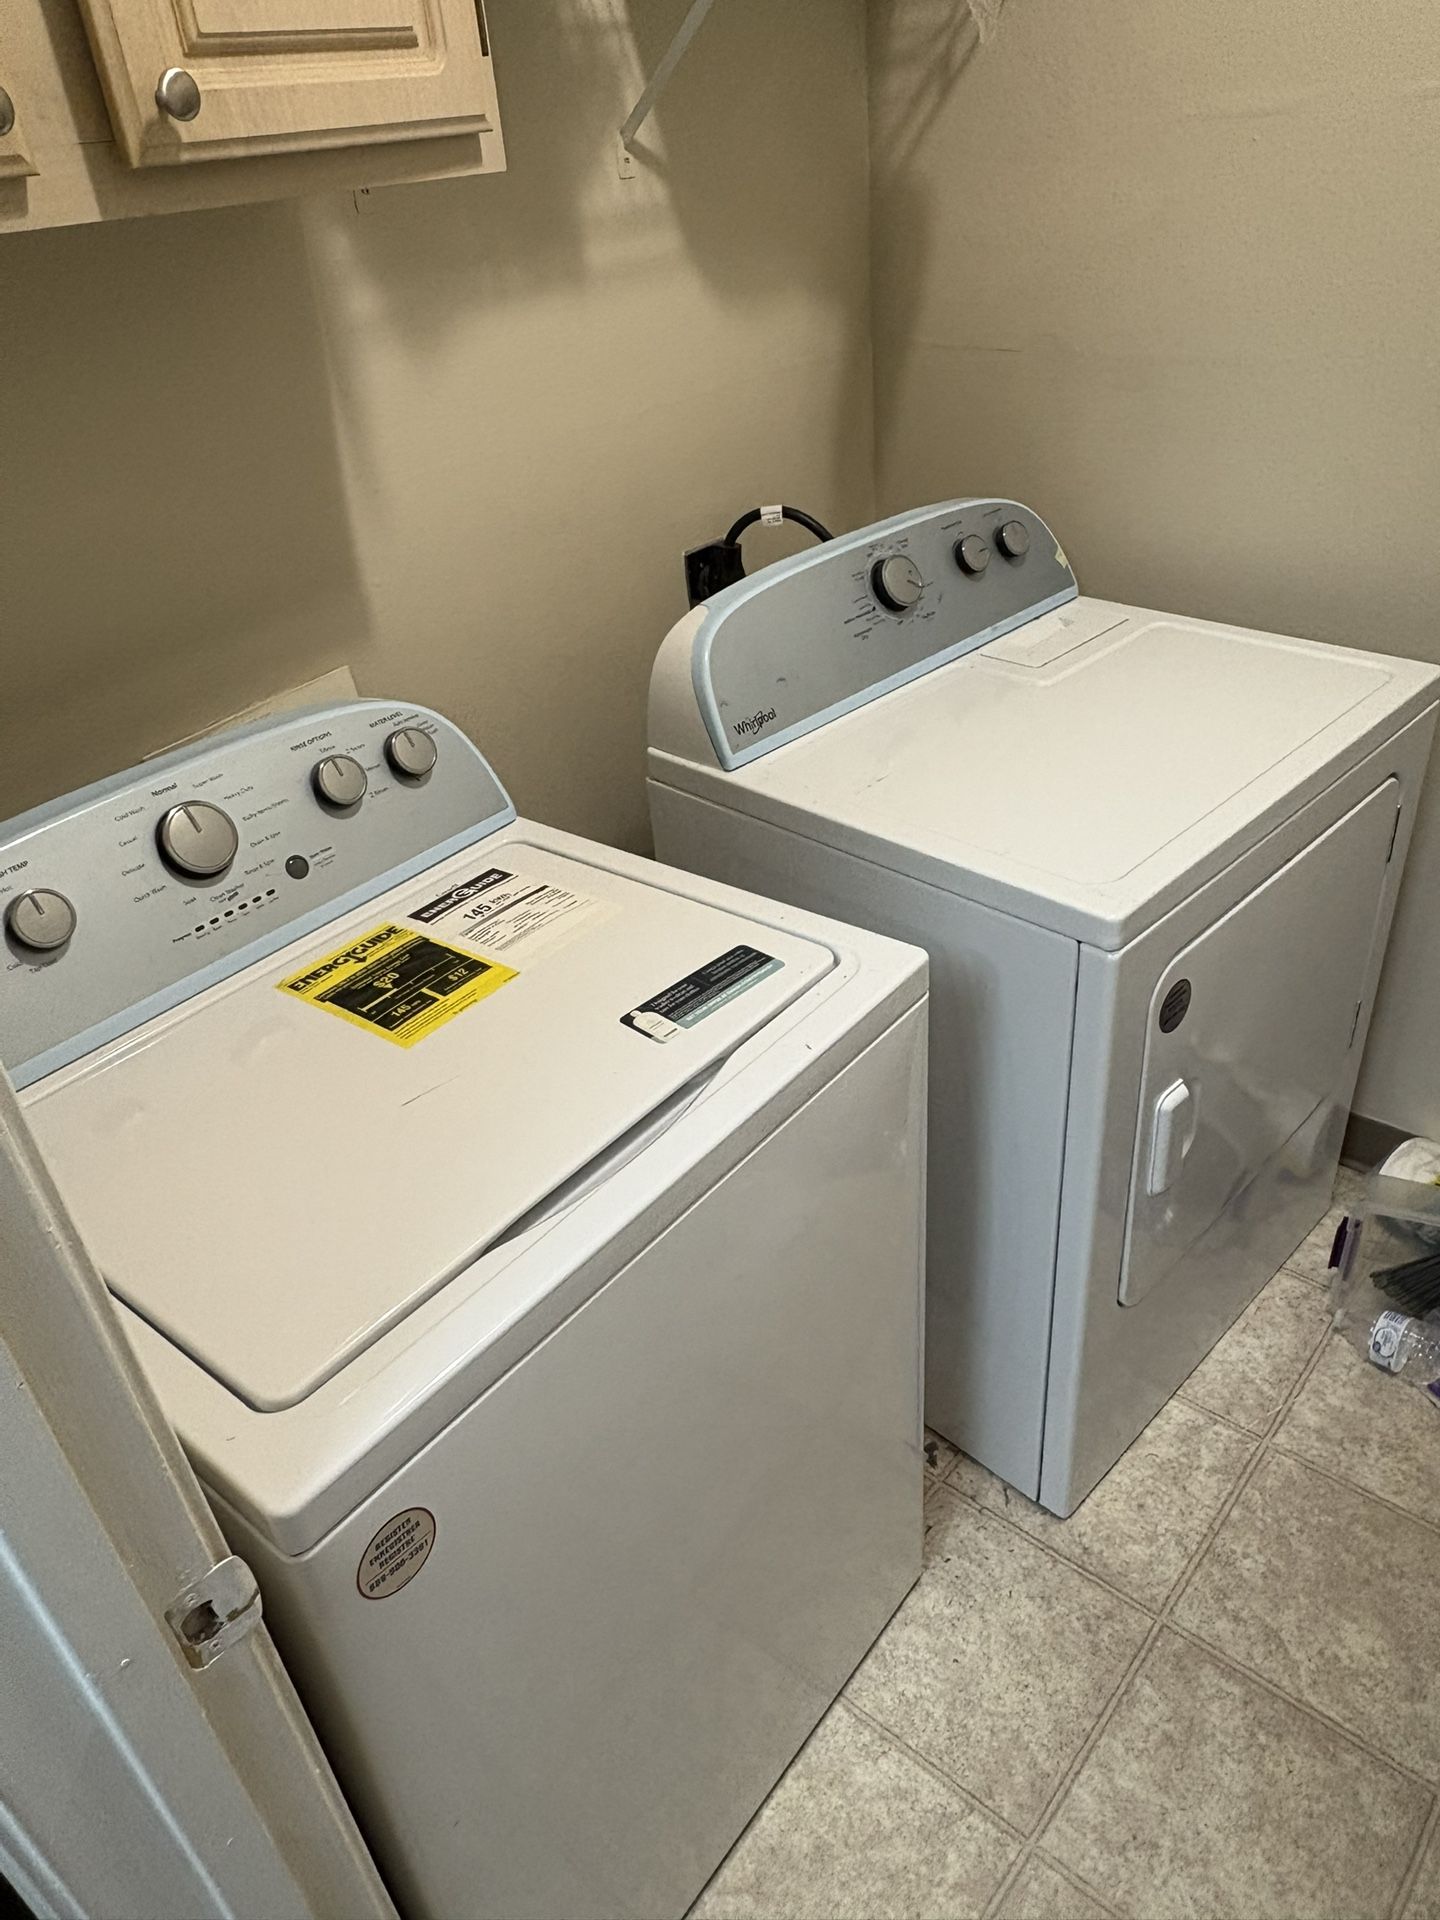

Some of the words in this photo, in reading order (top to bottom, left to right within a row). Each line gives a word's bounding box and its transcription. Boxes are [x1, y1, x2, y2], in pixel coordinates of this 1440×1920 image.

[733, 707, 777, 735] Whirlpool
[307, 731, 332, 745] OPTIONS
[151, 782, 178, 798] Normal
[8, 860, 29, 874] TEMP
[463, 903, 492, 920] 145
[287, 925, 402, 992] ENERGYGUIDE
[372, 972, 400, 989] $20
[448, 967, 470, 982] $12
[391, 1002, 411, 1018] 145
[374, 1516, 411, 1552] REGISTER
